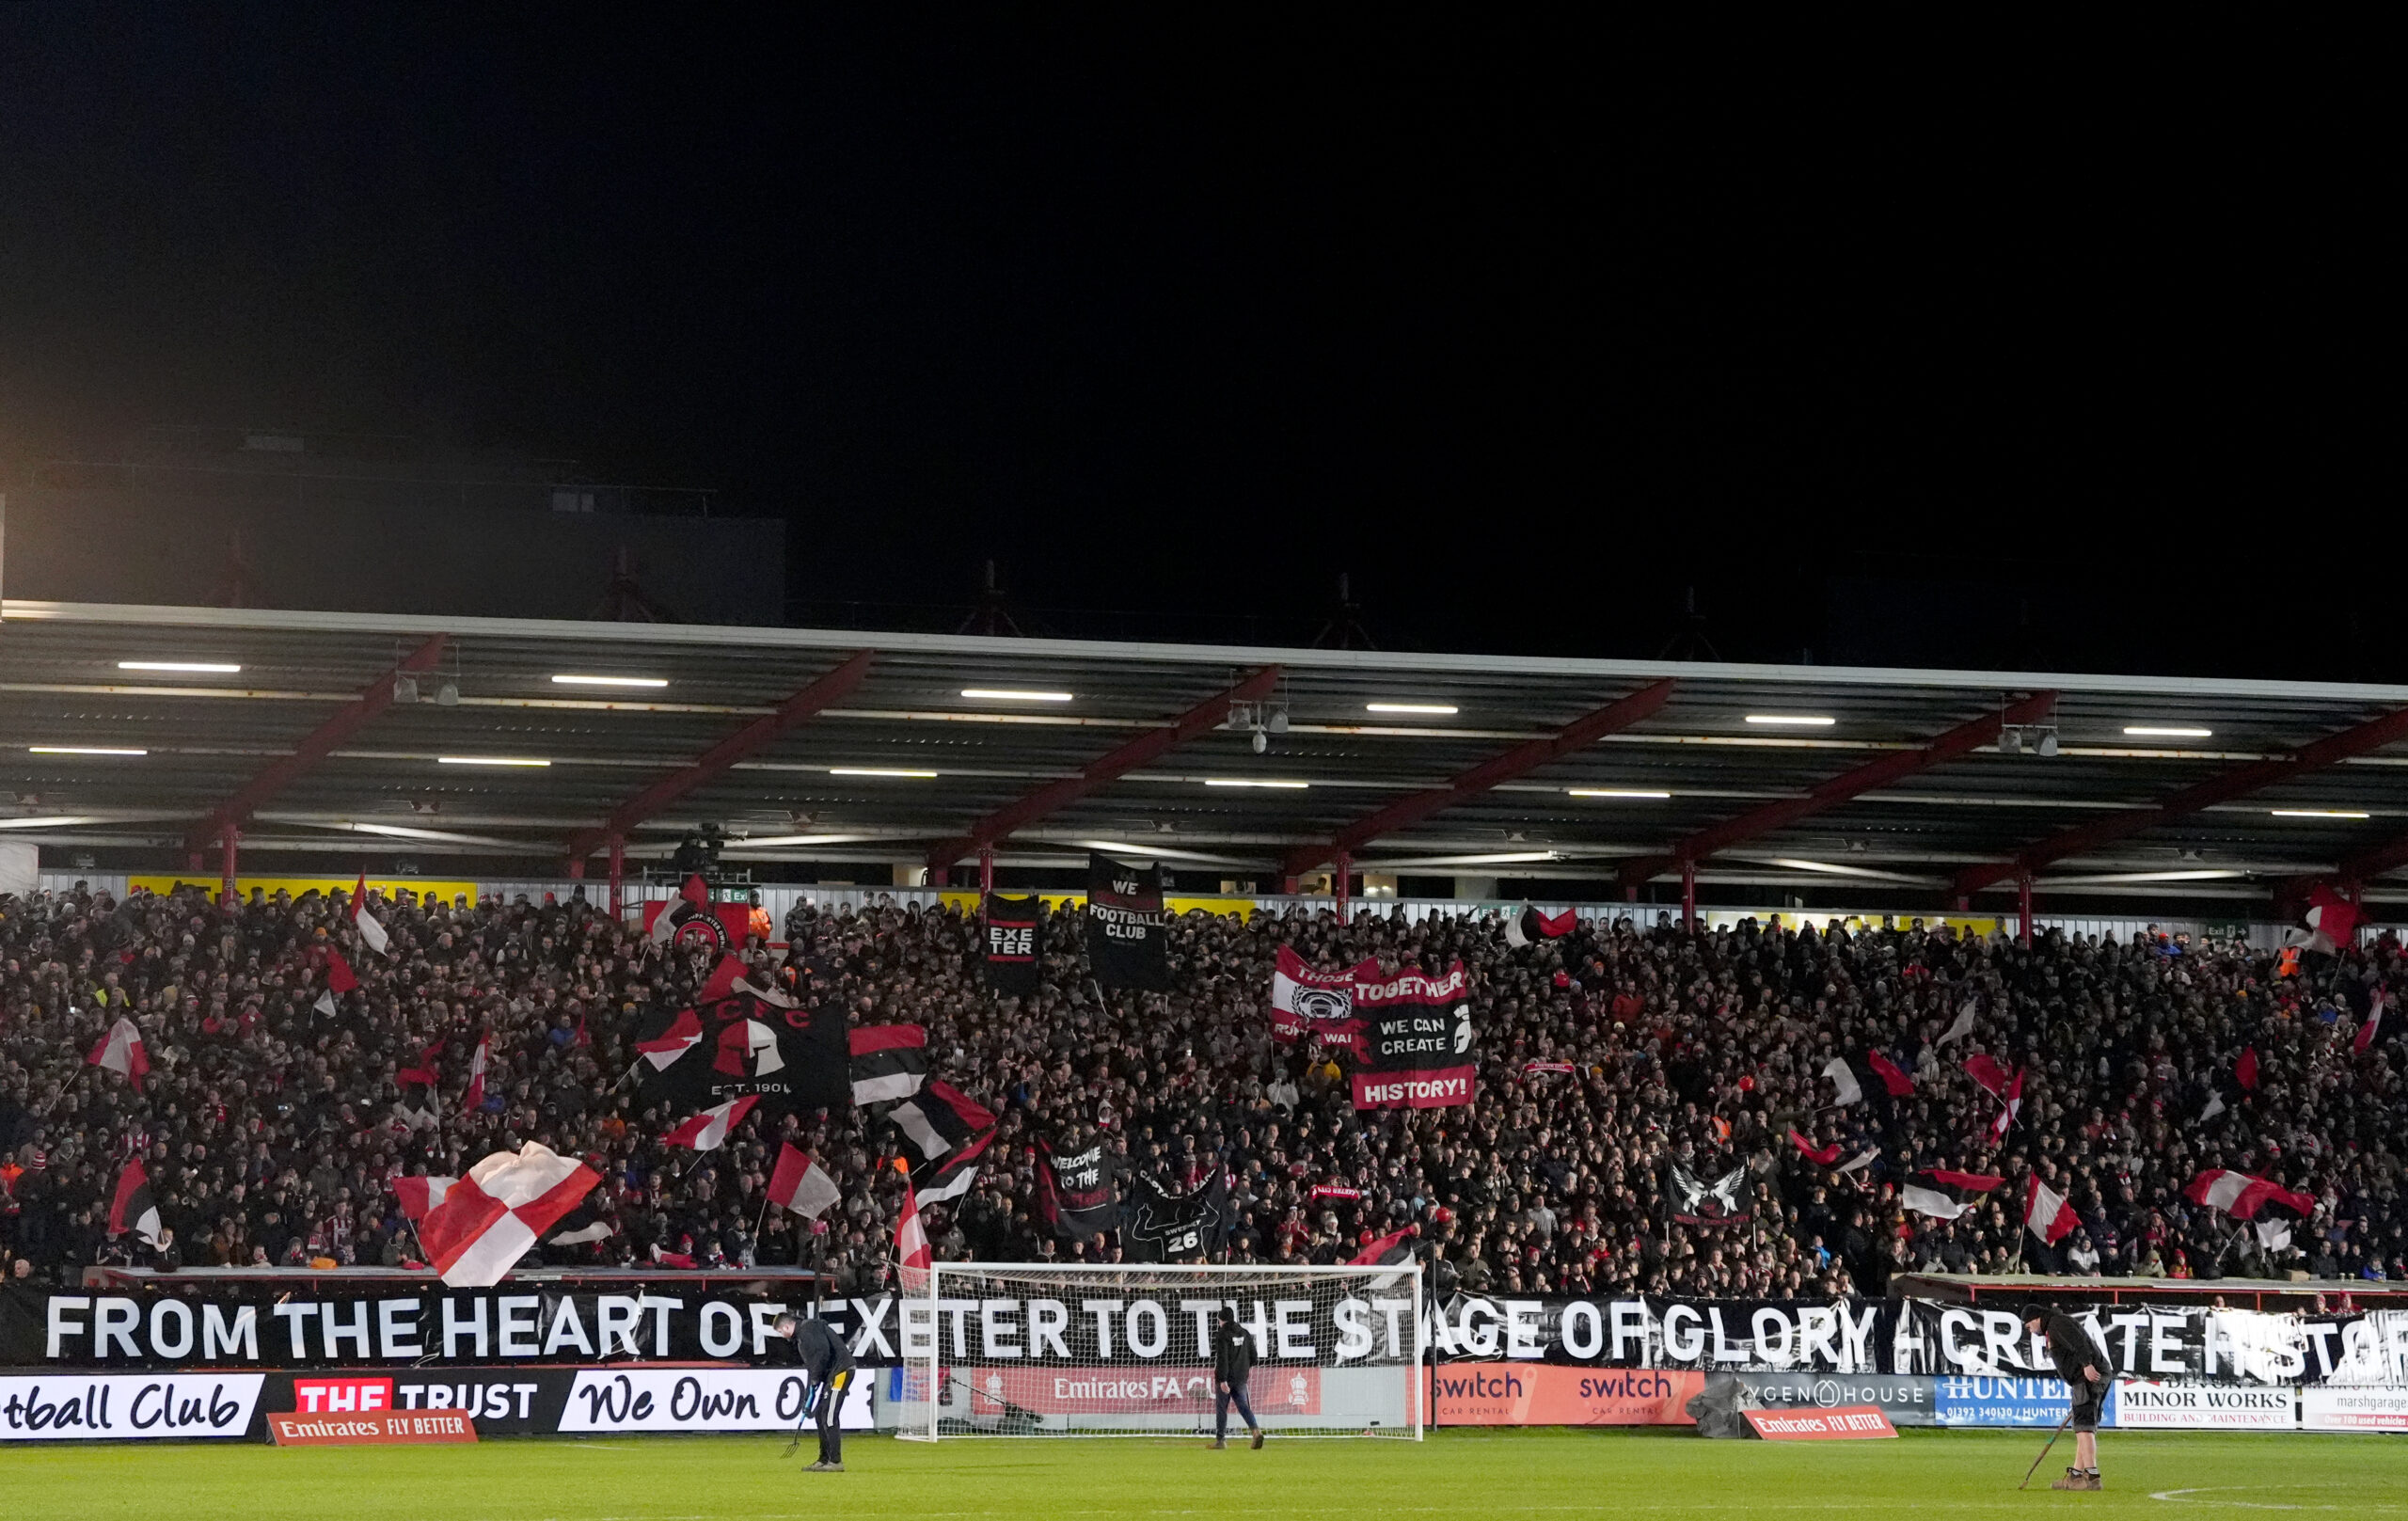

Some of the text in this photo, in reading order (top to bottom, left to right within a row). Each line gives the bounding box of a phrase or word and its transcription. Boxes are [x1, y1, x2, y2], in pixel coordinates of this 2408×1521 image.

[734, 892, 748, 901] Exi
[1112, 879, 1139, 895] WE
[1089, 903, 1164, 927] FOOTBALL
[990, 927, 1033, 941] EXE
[1106, 924, 1147, 940] CLUB
[2209, 927, 2225, 935] Exit
[989, 941, 1032, 955] TER
[1354, 971, 1464, 1001] TOGETHER
[1380, 1018, 1445, 1035] WE CAN
[1381, 1038, 1447, 1055] CREATE
[1364, 1078, 1467, 1103] HISTORY!
[1050, 1145, 1101, 1170] WELCOME
[1060, 1167, 1100, 1190] TO THE
[1167, 1231, 1198, 1252] 26
[46, 1295, 259, 1360] FROM
[274, 1297, 423, 1359] THE
[441, 1294, 684, 1358] HEART
[699, 1300, 788, 1357] OF
[1082, 1299, 1168, 1358] TO
[1180, 1299, 1317, 1358] THE
[1333, 1298, 1545, 1359] STAGE
[1561, 1300, 1646, 1360] OF
[1663, 1304, 1878, 1365] GLORY
[1054, 1376, 1148, 1399] Emirates
[1151, 1377, 1183, 1400] FA
[1579, 1371, 1671, 1398] switch
[1749, 1386, 1924, 1403] YGEN HOUSE
[3, 1383, 240, 1430] tball Club
[300, 1383, 537, 1419] THE TRUST
[579, 1374, 655, 1424] We
[671, 1375, 759, 1421] Own
[2124, 1392, 2288, 1409] MINOR WORKS
[1946, 1406, 1974, 1418] 01392
[1978, 1406, 2013, 1418] 340130
[2124, 1414, 2287, 1424] BUILDING AND MAINTENANCE
[2324, 1415, 2341, 1424] Over
[2358, 1416, 2376, 1425] used
[2377, 1416, 2406, 1426] vehicles
[278, 1417, 465, 1438] Emirates FLY BETTER
[1754, 1413, 1886, 1434] Emirates FLY BETTER
